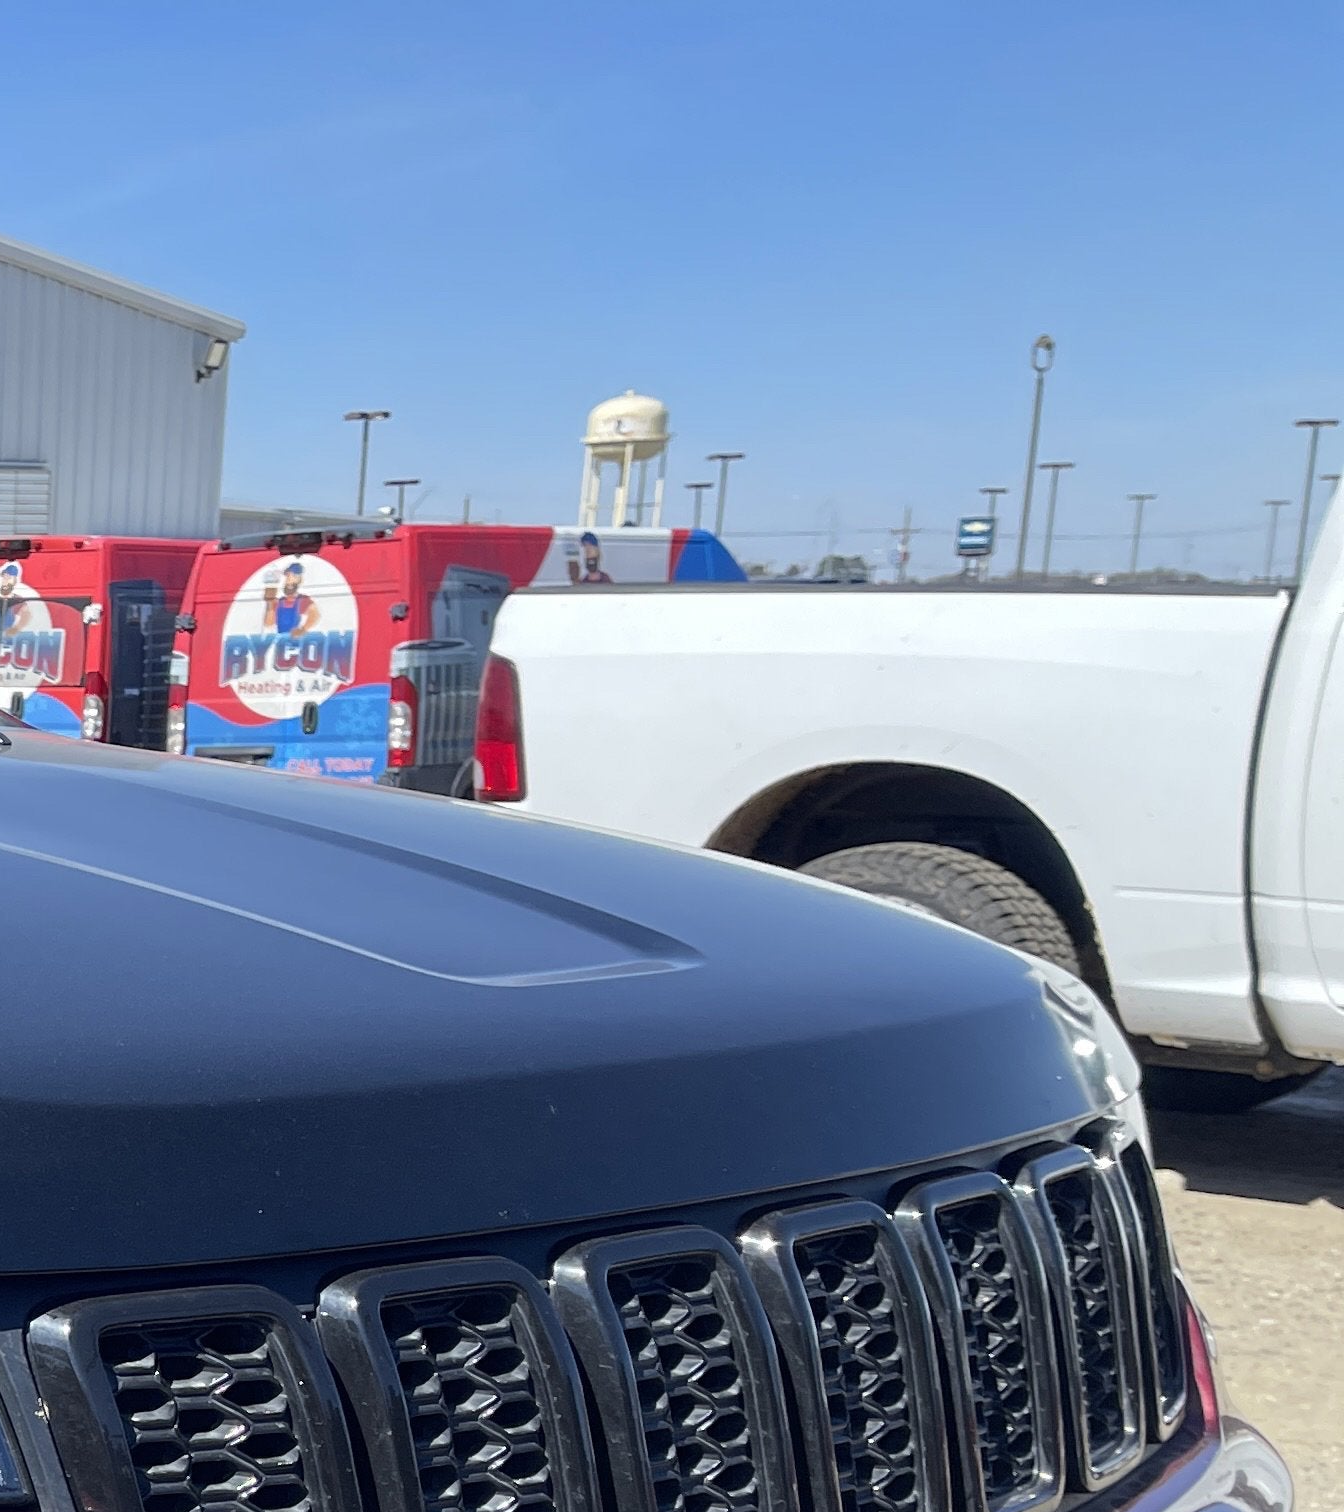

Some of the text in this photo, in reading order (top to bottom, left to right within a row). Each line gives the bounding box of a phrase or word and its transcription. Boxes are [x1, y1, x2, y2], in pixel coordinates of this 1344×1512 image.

[237, 679, 333, 696] Heating & Air
